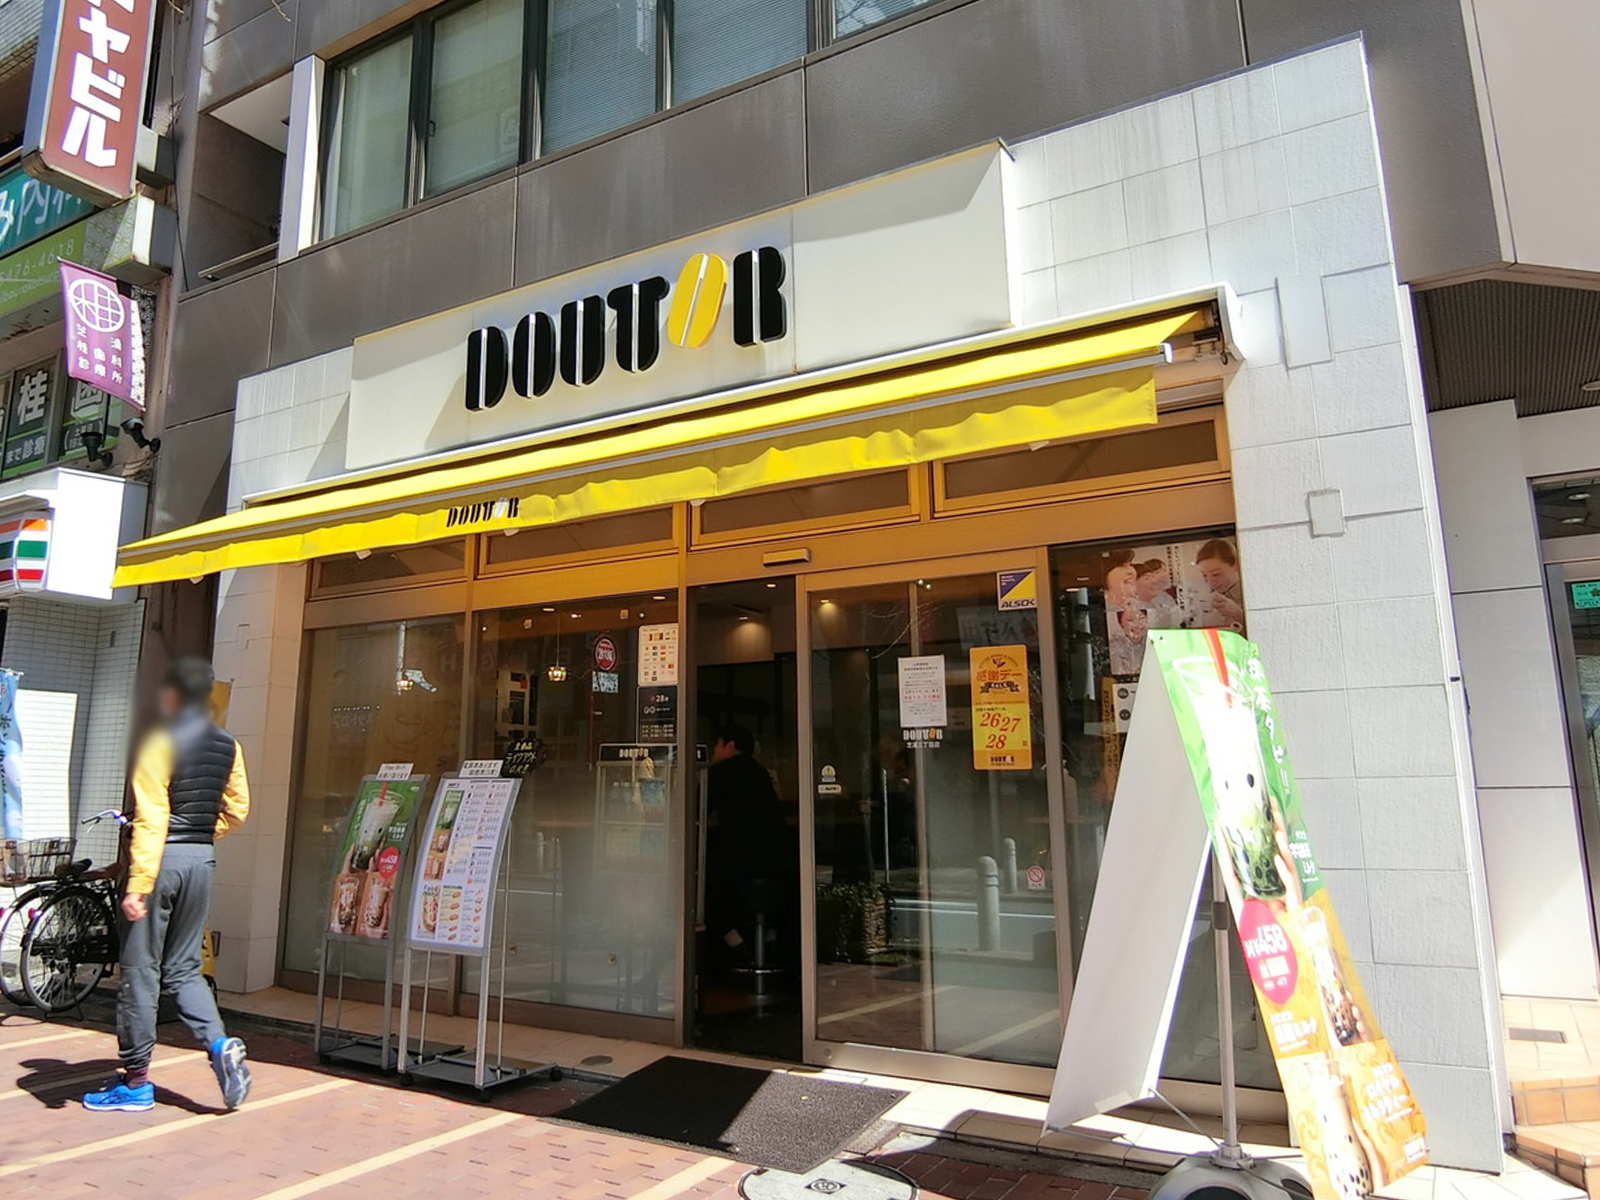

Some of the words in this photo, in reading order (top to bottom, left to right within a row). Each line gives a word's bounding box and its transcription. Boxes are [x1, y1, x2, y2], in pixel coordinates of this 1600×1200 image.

[62, 0, 134, 167] ヤビル
[465, 246, 787, 412] DOUTOR
[18, 370, 48, 425] 桂
[446, 497, 519, 528] DOUTOR
[1000, 598, 1036, 609] ALSOK
[903, 728, 943, 740] DOUTOR
[979, 711, 1001, 728] 26
[1000, 716, 1021, 732] 27
[985, 733, 1007, 749] 28
